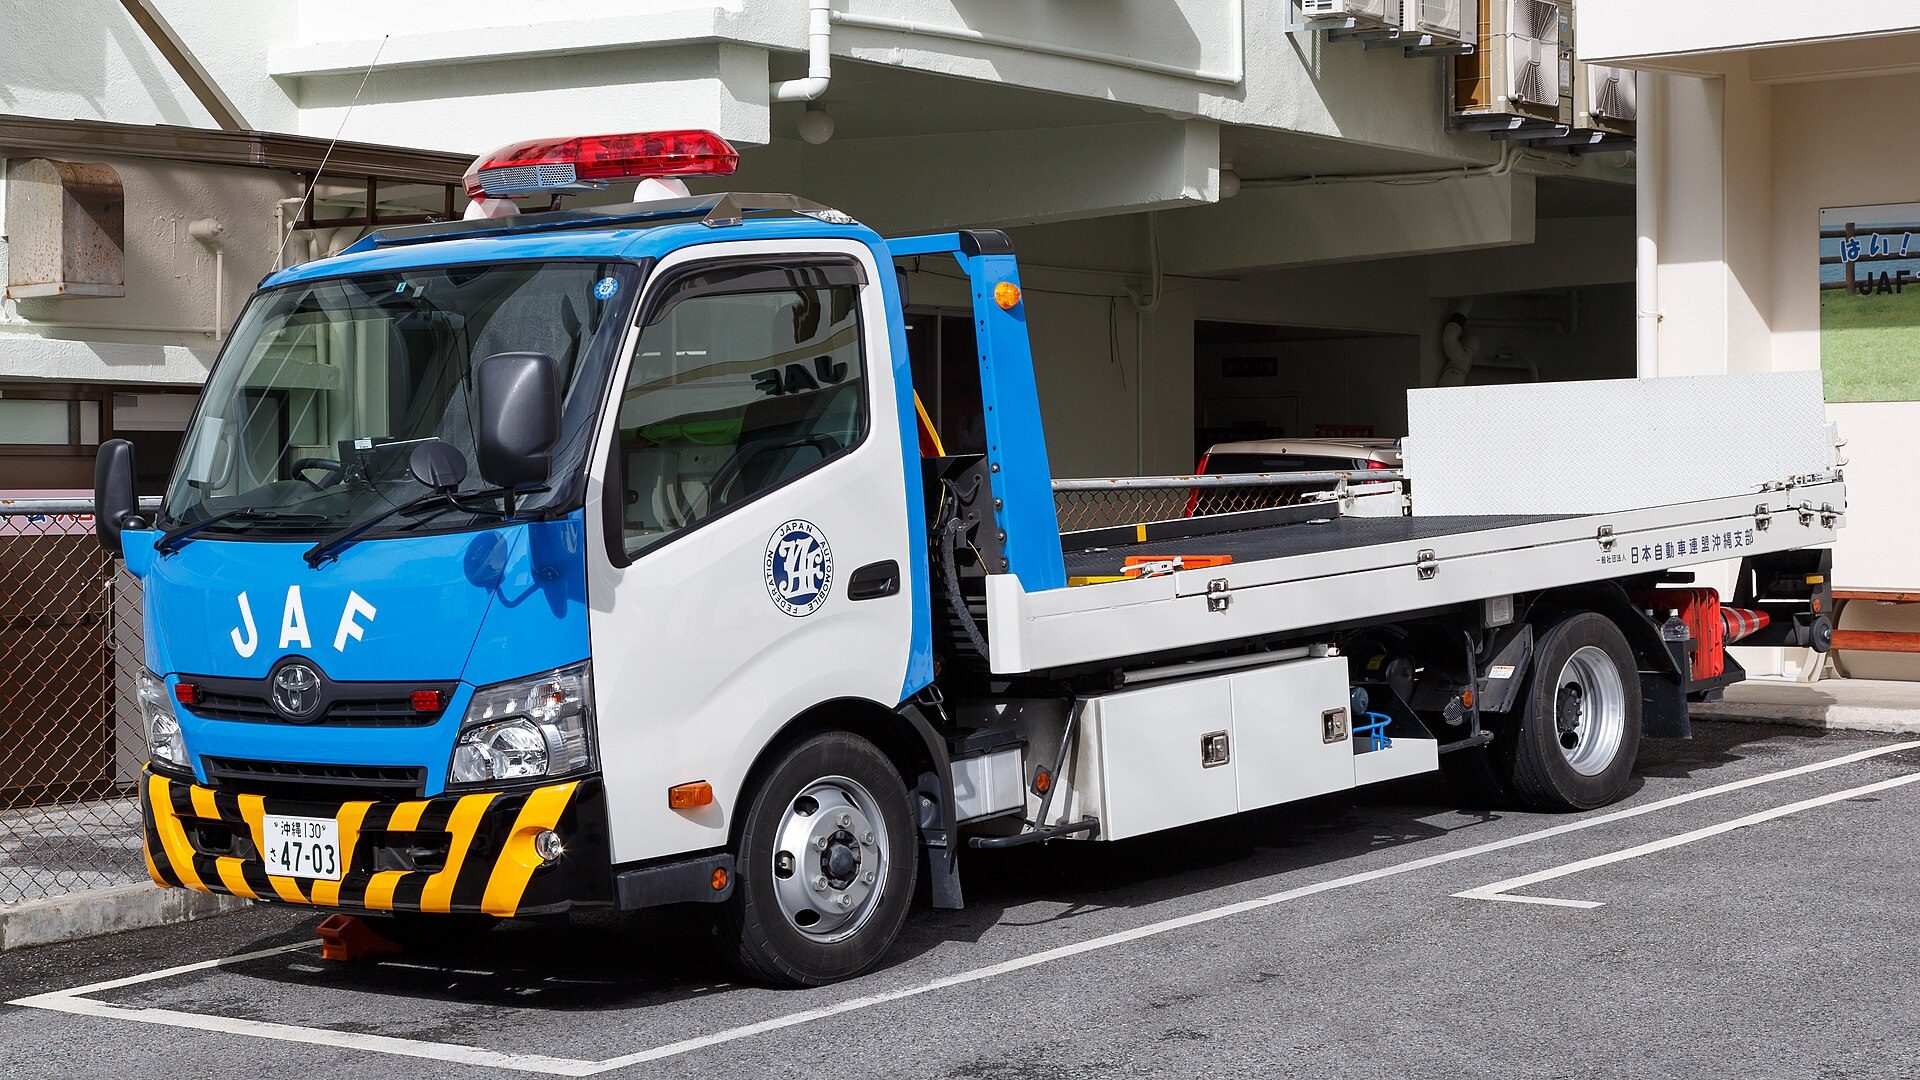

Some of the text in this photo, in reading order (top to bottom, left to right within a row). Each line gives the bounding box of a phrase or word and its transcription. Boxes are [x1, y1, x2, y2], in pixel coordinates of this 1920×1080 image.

[1859, 270, 1920, 296] JAF
[1631, 528, 1754, 564] 日本自動車連盟沖縄支部
[766, 522, 832, 614] JAPAN AUTOMOBILE FEDERATION
[230, 585, 377, 659] JAF
[270, 841, 335, 874] さ 47-03
